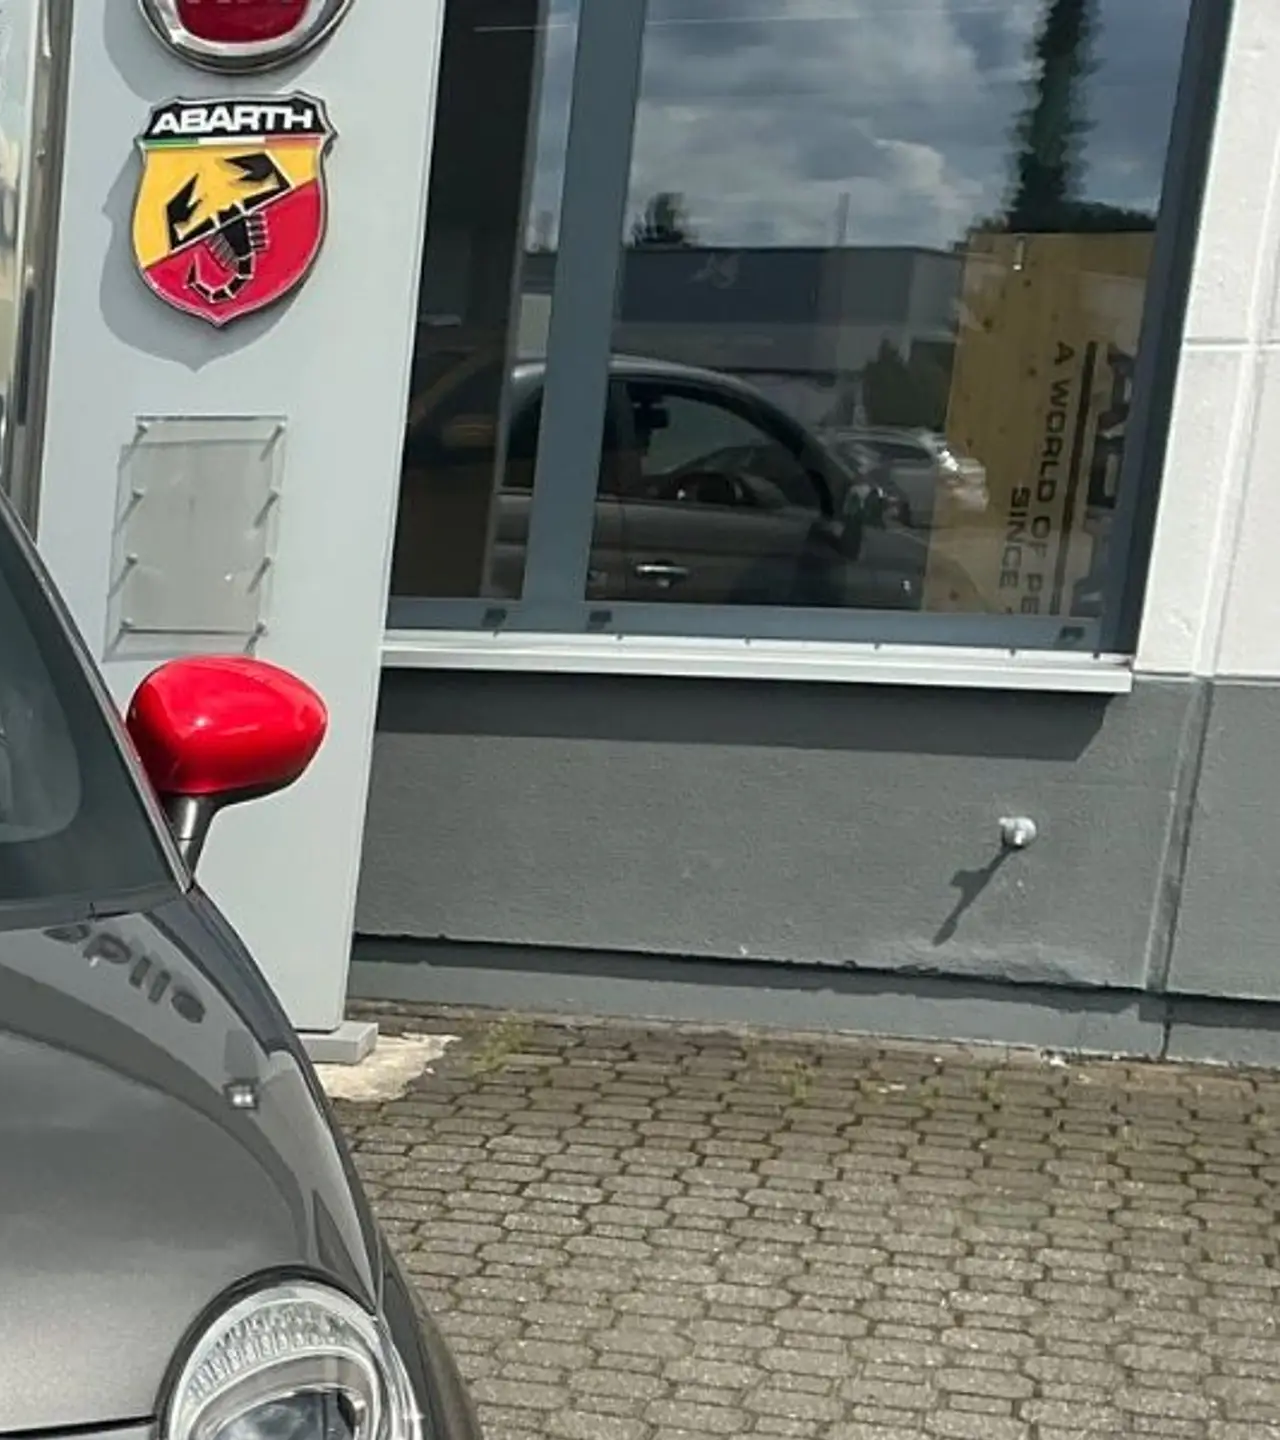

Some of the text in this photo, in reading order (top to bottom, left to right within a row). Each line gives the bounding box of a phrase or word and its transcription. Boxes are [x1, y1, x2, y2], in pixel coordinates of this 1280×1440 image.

[152, 104, 314, 135] ABARTH
[1054, 340, 1075, 366] A
[1037, 379, 1072, 503] WORLD
[999, 486, 1031, 589] SINCE
